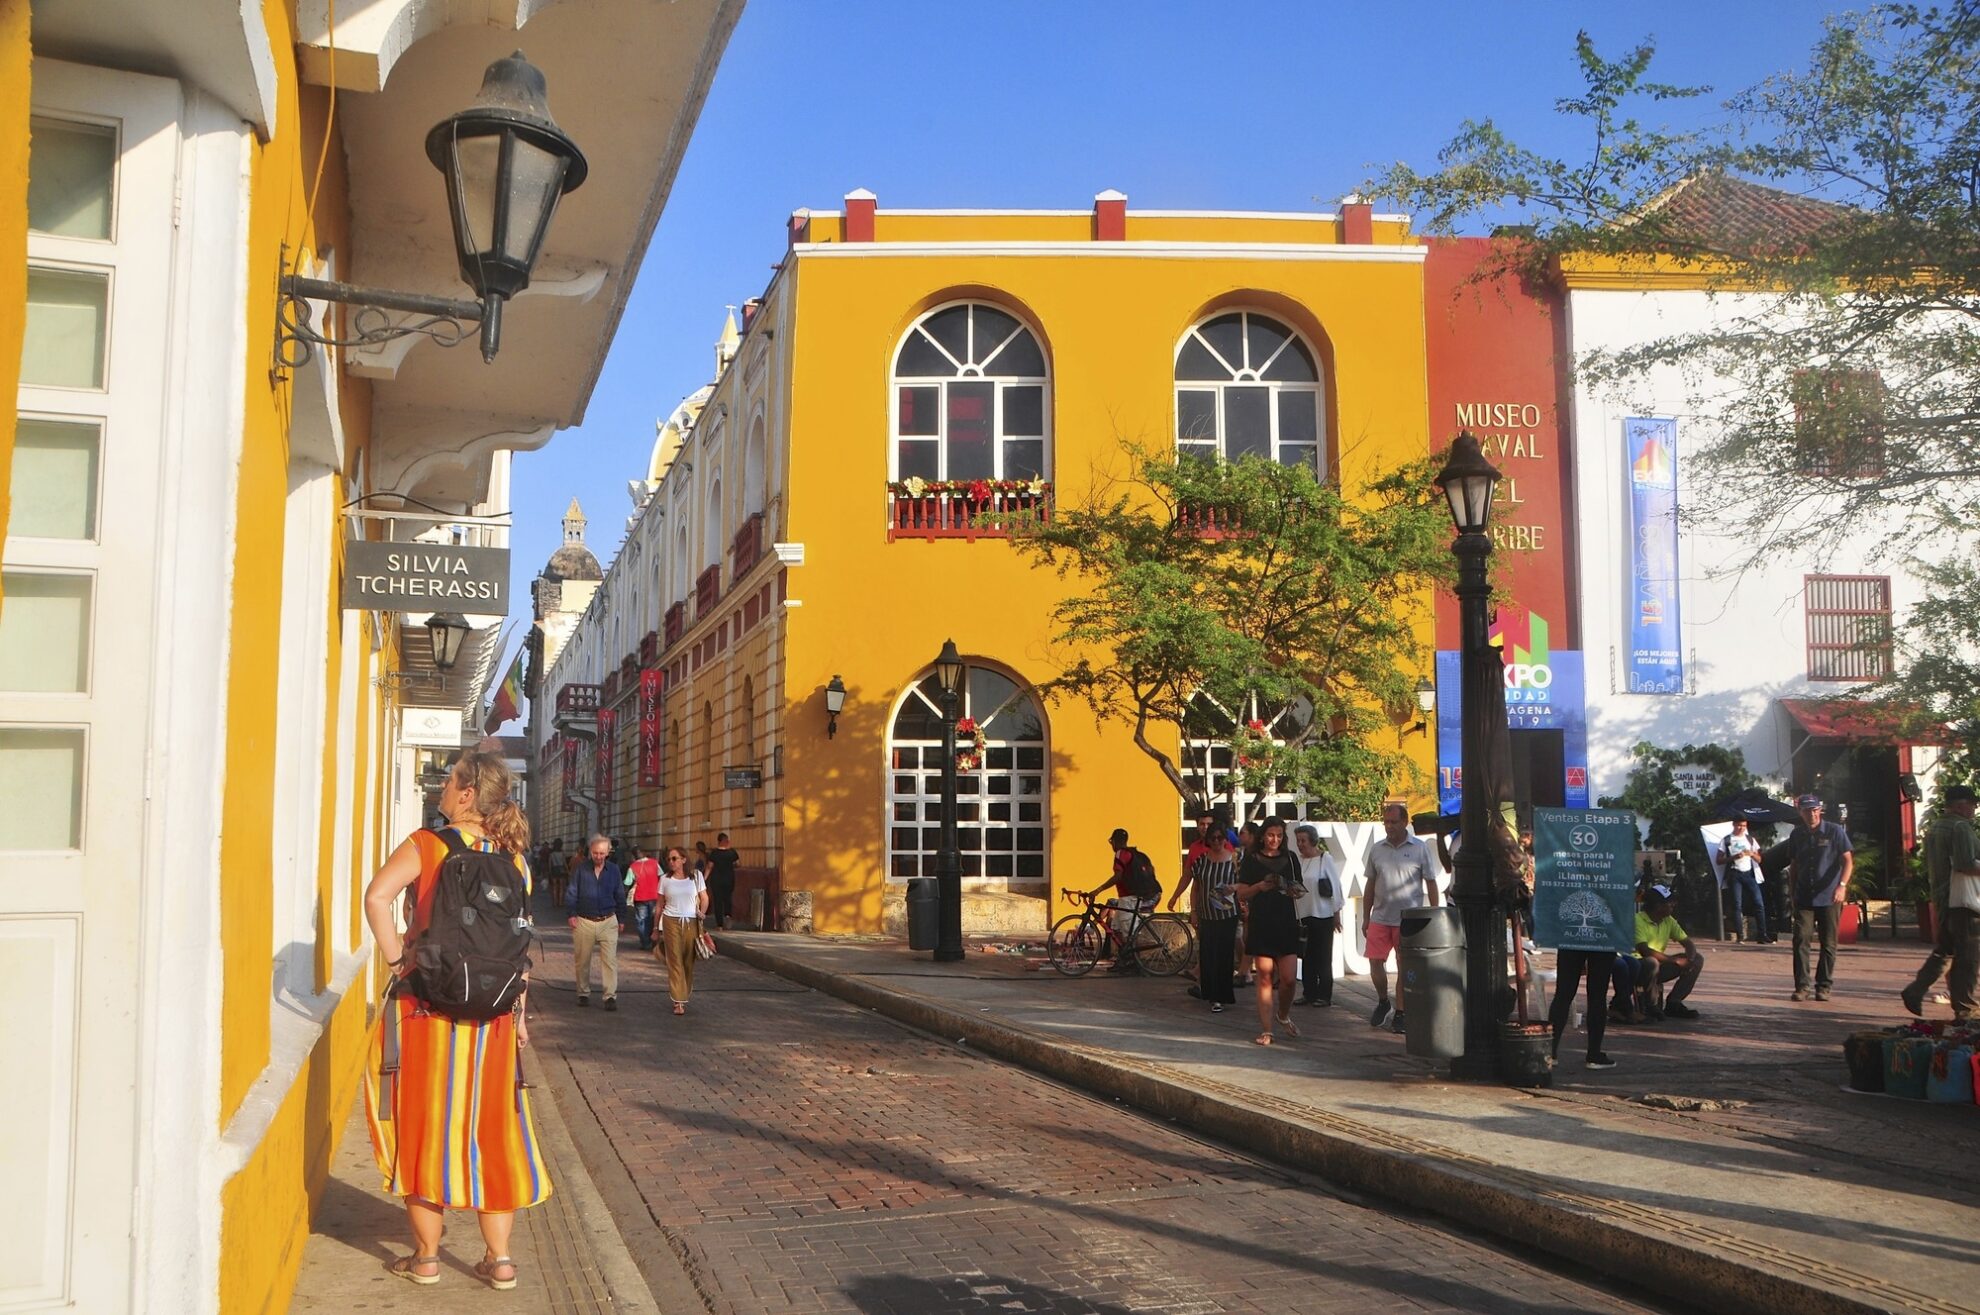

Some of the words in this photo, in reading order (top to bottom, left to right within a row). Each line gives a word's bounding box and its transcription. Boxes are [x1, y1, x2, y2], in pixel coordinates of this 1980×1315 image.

[1456, 403, 1541, 428] MUSEO
[1459, 433, 1544, 458] AVAL
[387, 554, 469, 575] SILVIA
[356, 576, 499, 600] TCHERASSI
[646, 679, 657, 722] MUSEO
[646, 724, 655, 767] NAVAL
[1683, 781, 1693, 789] DEL
[1696, 781, 1711, 789] MAR
[1540, 813, 1580, 823] Ventas
[1585, 814, 1620, 825] Etapa
[1623, 815, 1631, 824] 3
[1573, 832, 1597, 846] 30
[1556, 860, 1582, 868] cuota
[1584, 860, 1611, 869] inicial
[1583, 852, 1604, 860] para
[1606, 852, 1615, 860] la
[1593, 874, 1609, 882] ya!
